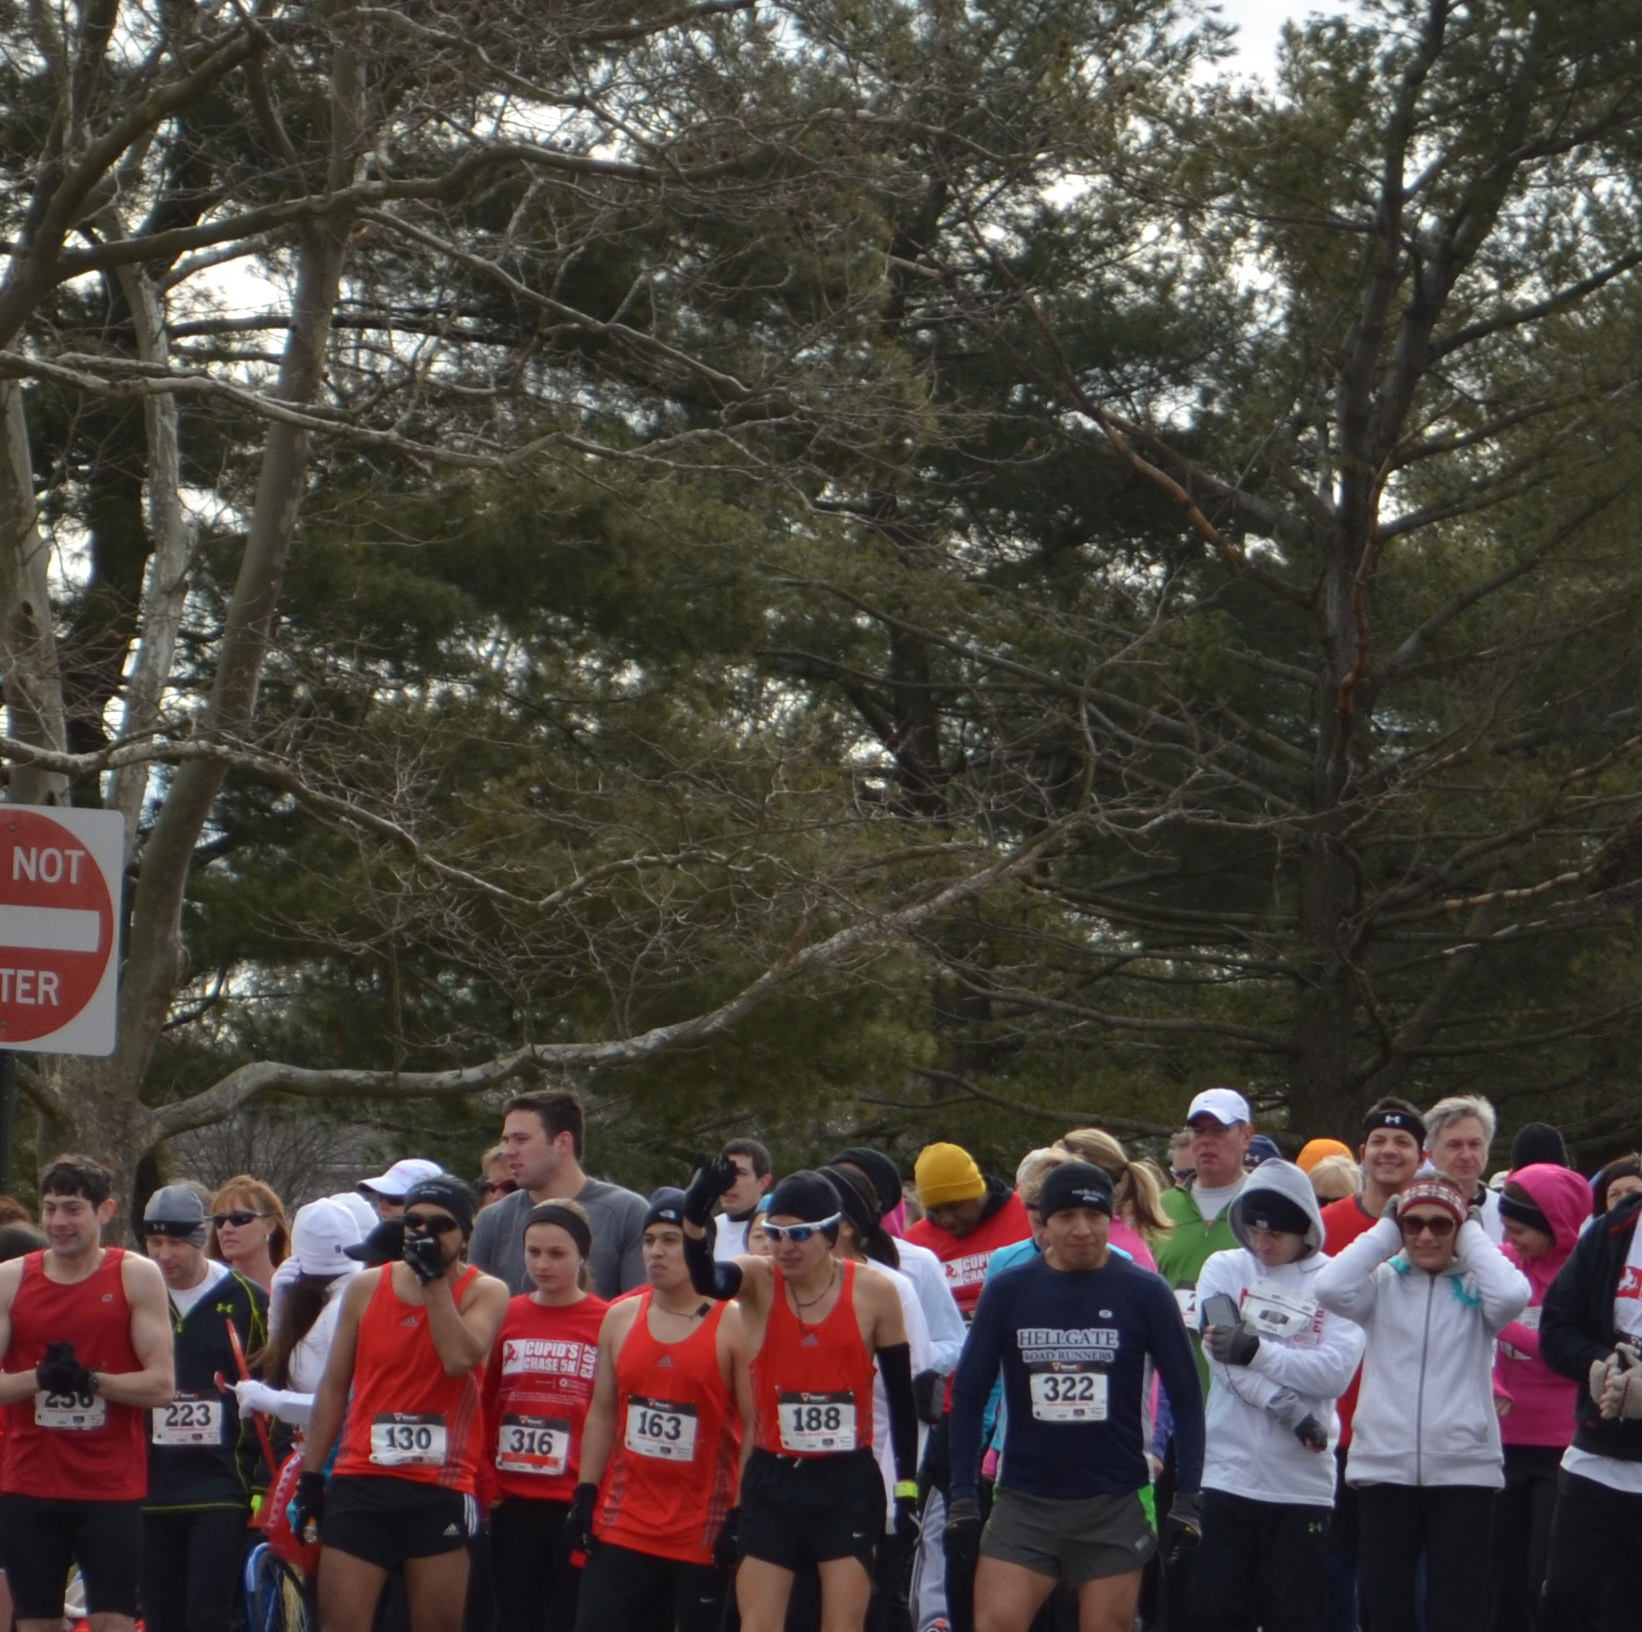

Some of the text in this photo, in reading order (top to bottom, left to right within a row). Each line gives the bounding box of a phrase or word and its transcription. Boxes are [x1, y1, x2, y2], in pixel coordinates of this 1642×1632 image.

[12, 846, 86, 885] NOT
[524, 1341, 579, 1360] CUPID'S
[1018, 1330, 1118, 1347] HELLGATE
[523, 1356, 577, 1374] CHASE 5K
[579, 1344, 598, 1379] 2013
[1024, 1349, 1113, 1361] ROAD RUNNERS
[1043, 1376, 1094, 1402] 322
[165, 1404, 212, 1428] 223
[637, 1410, 682, 1441] 163
[793, 1406, 841, 1432] 188
[385, 1426, 432, 1451] 130
[510, 1428, 554, 1456] 316
